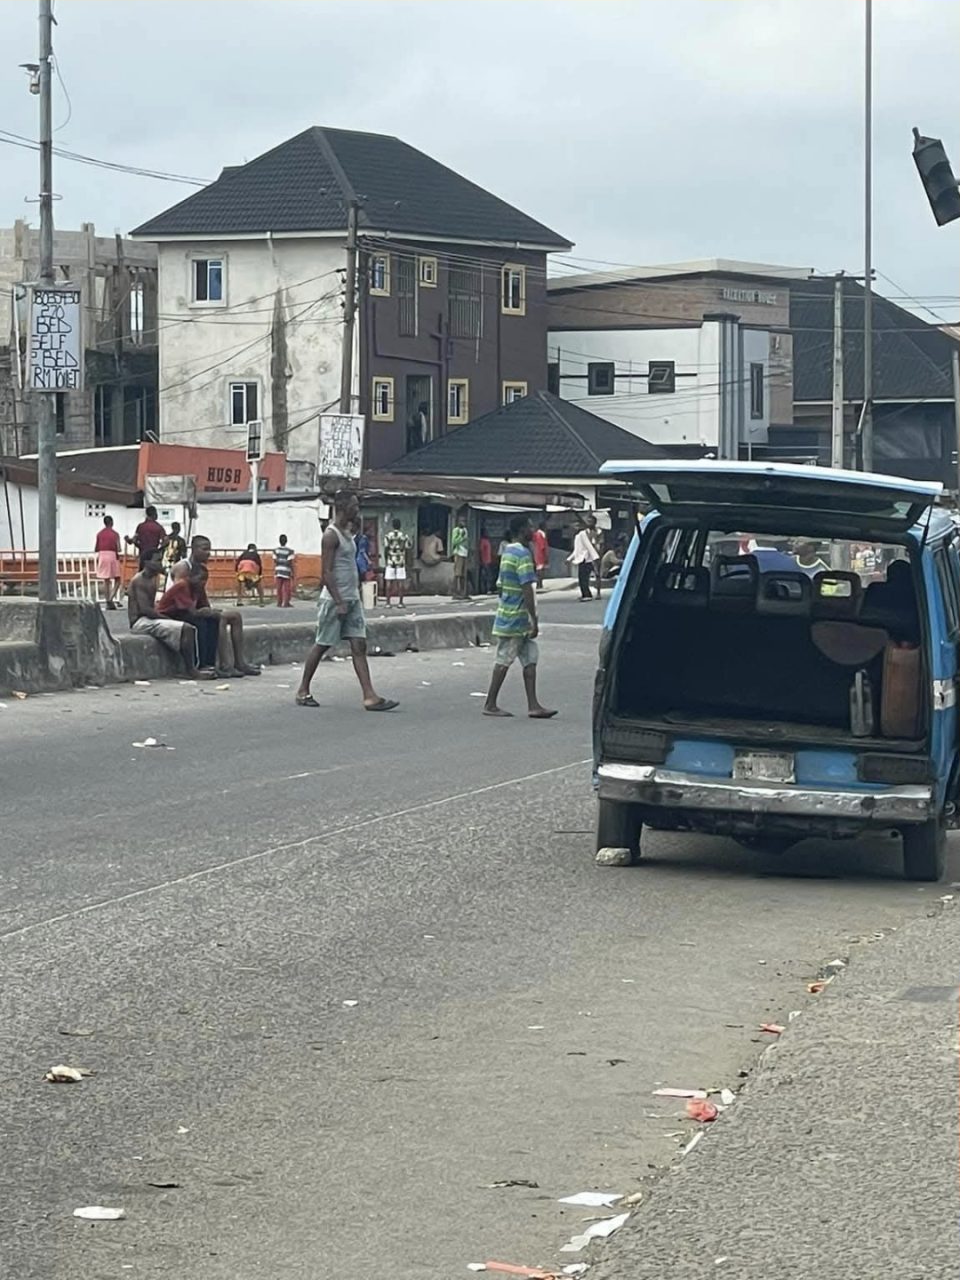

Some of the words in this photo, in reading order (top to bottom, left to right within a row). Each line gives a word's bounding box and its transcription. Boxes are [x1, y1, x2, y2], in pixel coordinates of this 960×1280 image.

[36, 316, 73, 335] BED
[31, 334, 67, 351] SELF
[42, 349, 79, 369] BED
[34, 366, 51, 389] RM
[207, 466, 242, 485] HUSH
